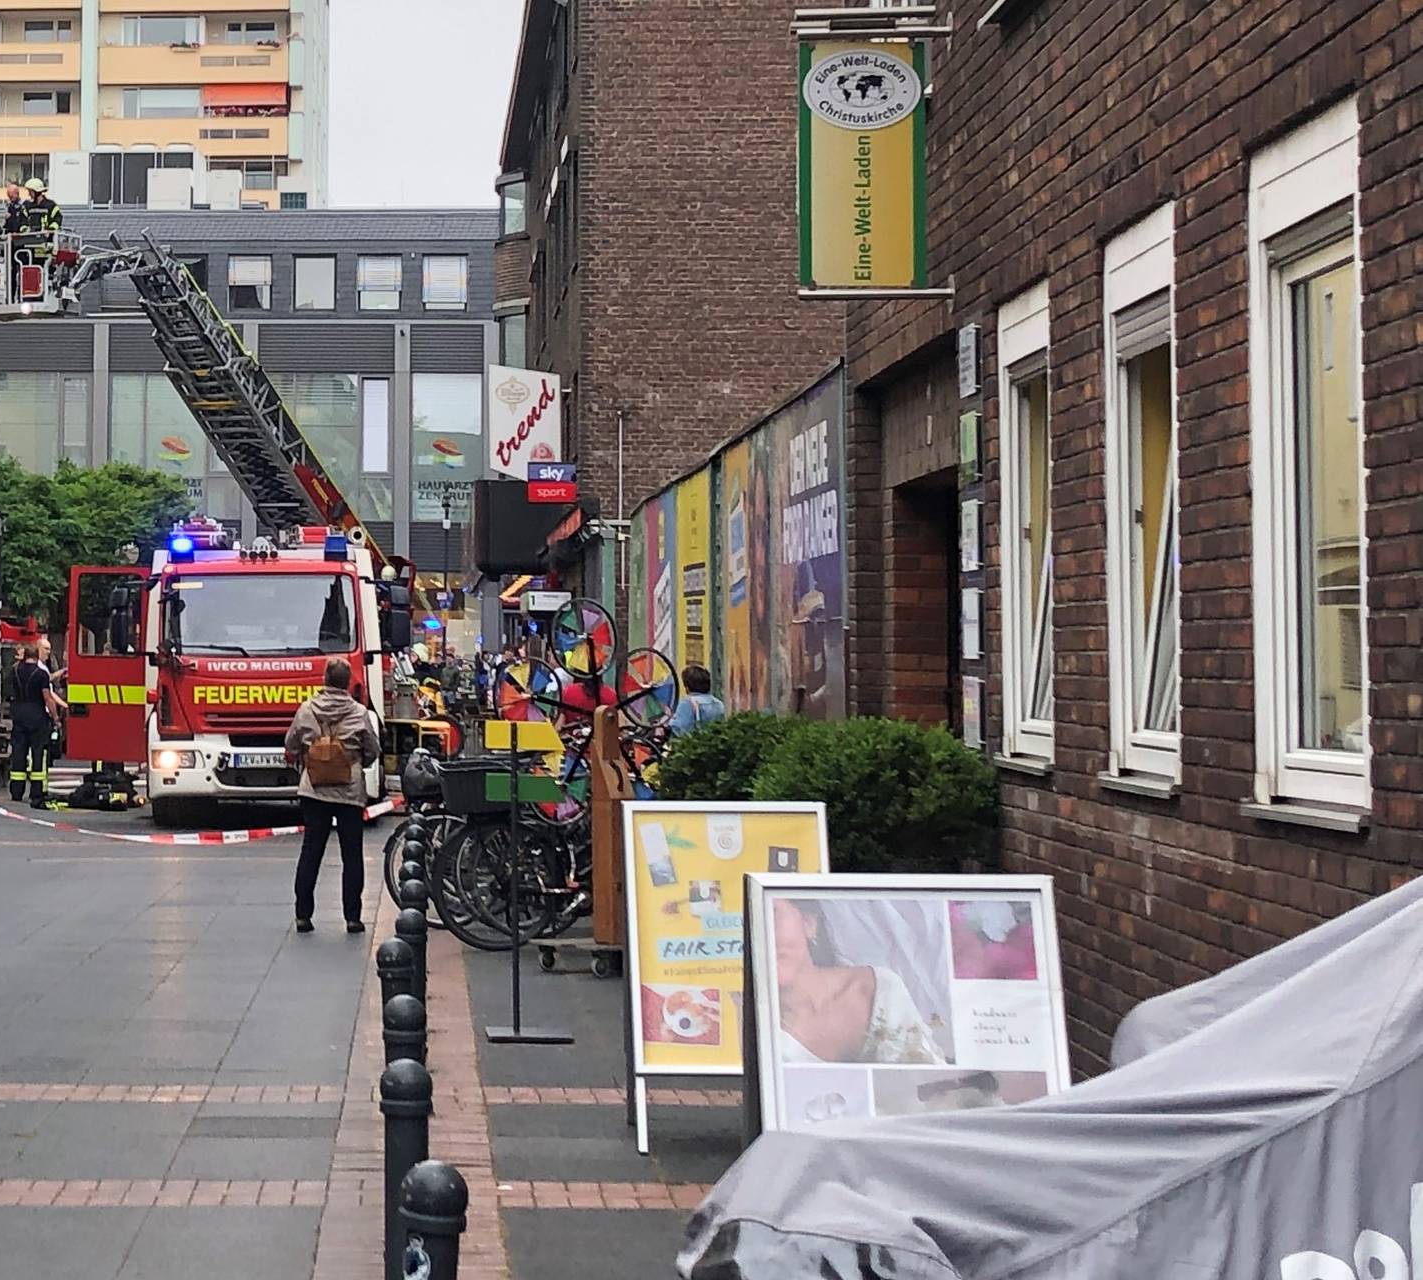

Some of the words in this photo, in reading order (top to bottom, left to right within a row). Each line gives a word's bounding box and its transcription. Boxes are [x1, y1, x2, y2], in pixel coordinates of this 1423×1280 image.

[815, 55, 907, 84] Eine-Welt-Laden
[818, 100, 905, 124] Christuskirche
[854, 135, 872, 281] Eine-Welt-Laden
[496, 378, 556, 467] trend
[539, 466, 565, 481] sky
[536, 487, 567, 498] sport
[207, 661, 248, 671] IVECO
[251, 661, 313, 671] MAGIRUS
[662, 941, 710, 959] FAIR
